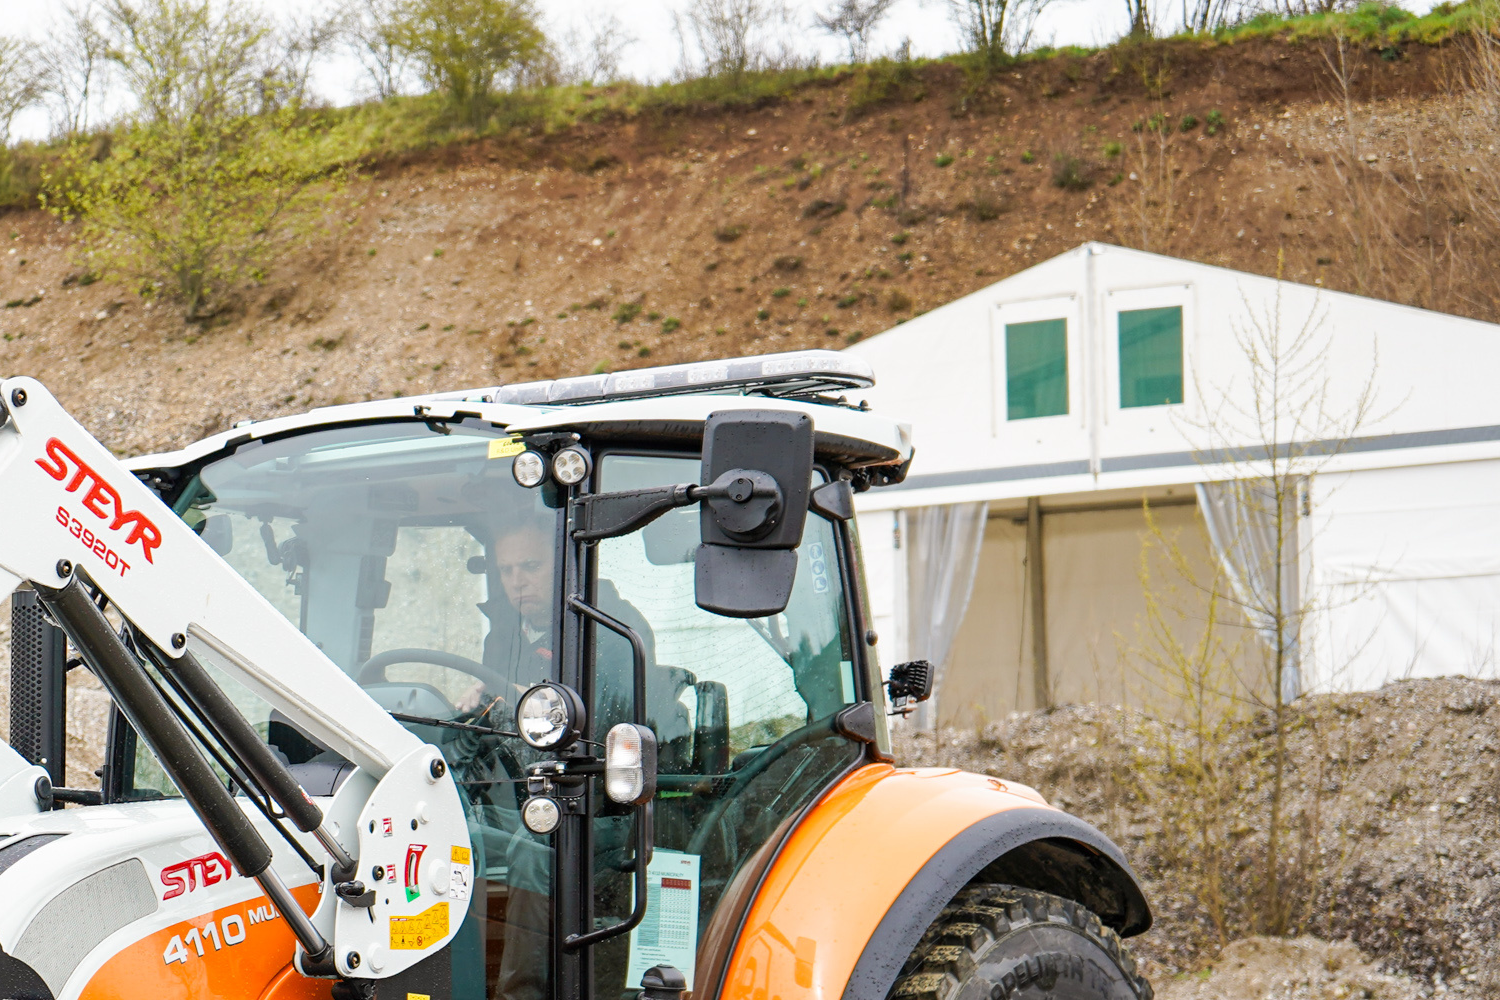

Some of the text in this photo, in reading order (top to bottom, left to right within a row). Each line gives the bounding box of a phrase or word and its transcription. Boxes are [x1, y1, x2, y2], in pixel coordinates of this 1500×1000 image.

[34, 436, 163, 565] STEYR
[55, 505, 132, 578] S3920T
[160, 851, 233, 901] STEY
[162, 903, 280, 965] 4110 MU
